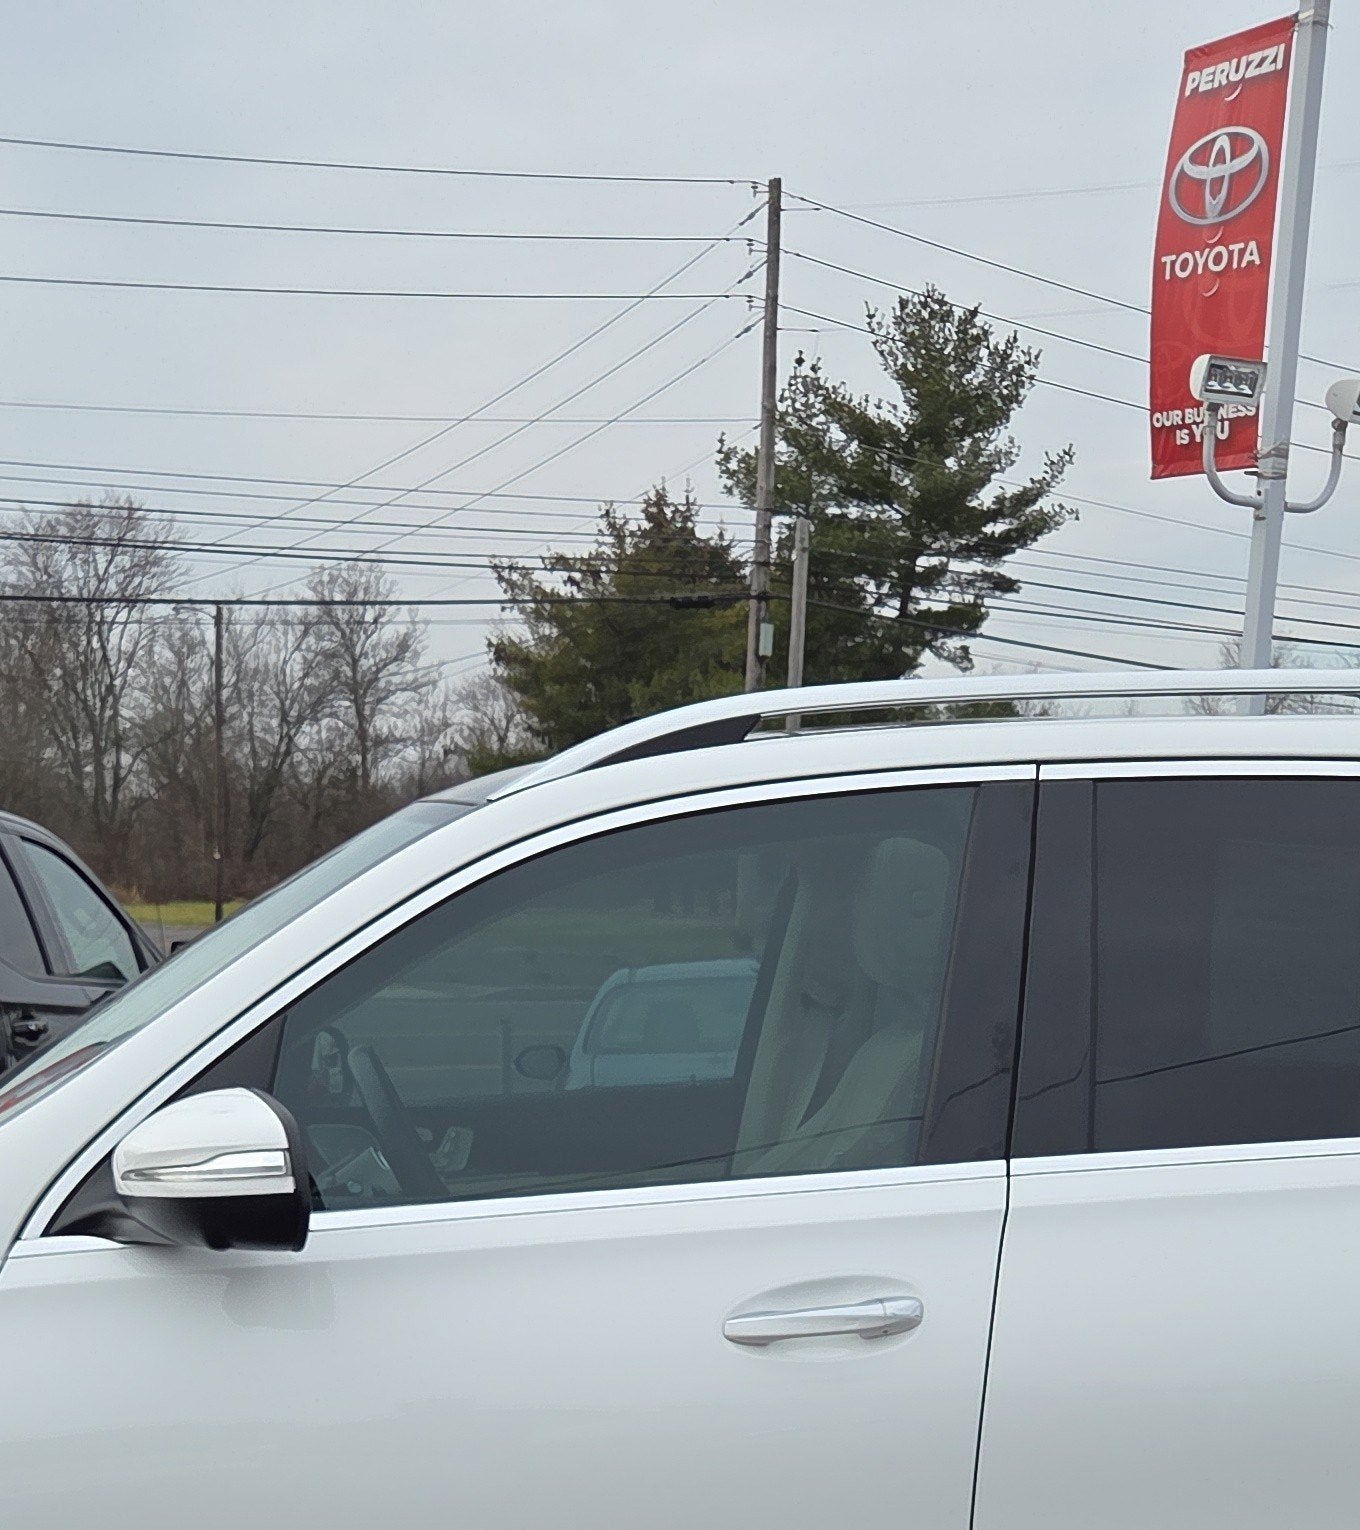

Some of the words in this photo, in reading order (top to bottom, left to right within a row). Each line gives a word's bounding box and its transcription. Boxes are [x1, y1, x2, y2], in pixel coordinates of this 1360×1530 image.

[1185, 43, 1286, 97] PERUZZI
[1160, 240, 1261, 281] TOYOTA
[1152, 409, 1183, 428] OUR
[1185, 403, 1257, 424] BUNESS
[1175, 428, 1190, 446] IS
[1191, 420, 1229, 442] YU
